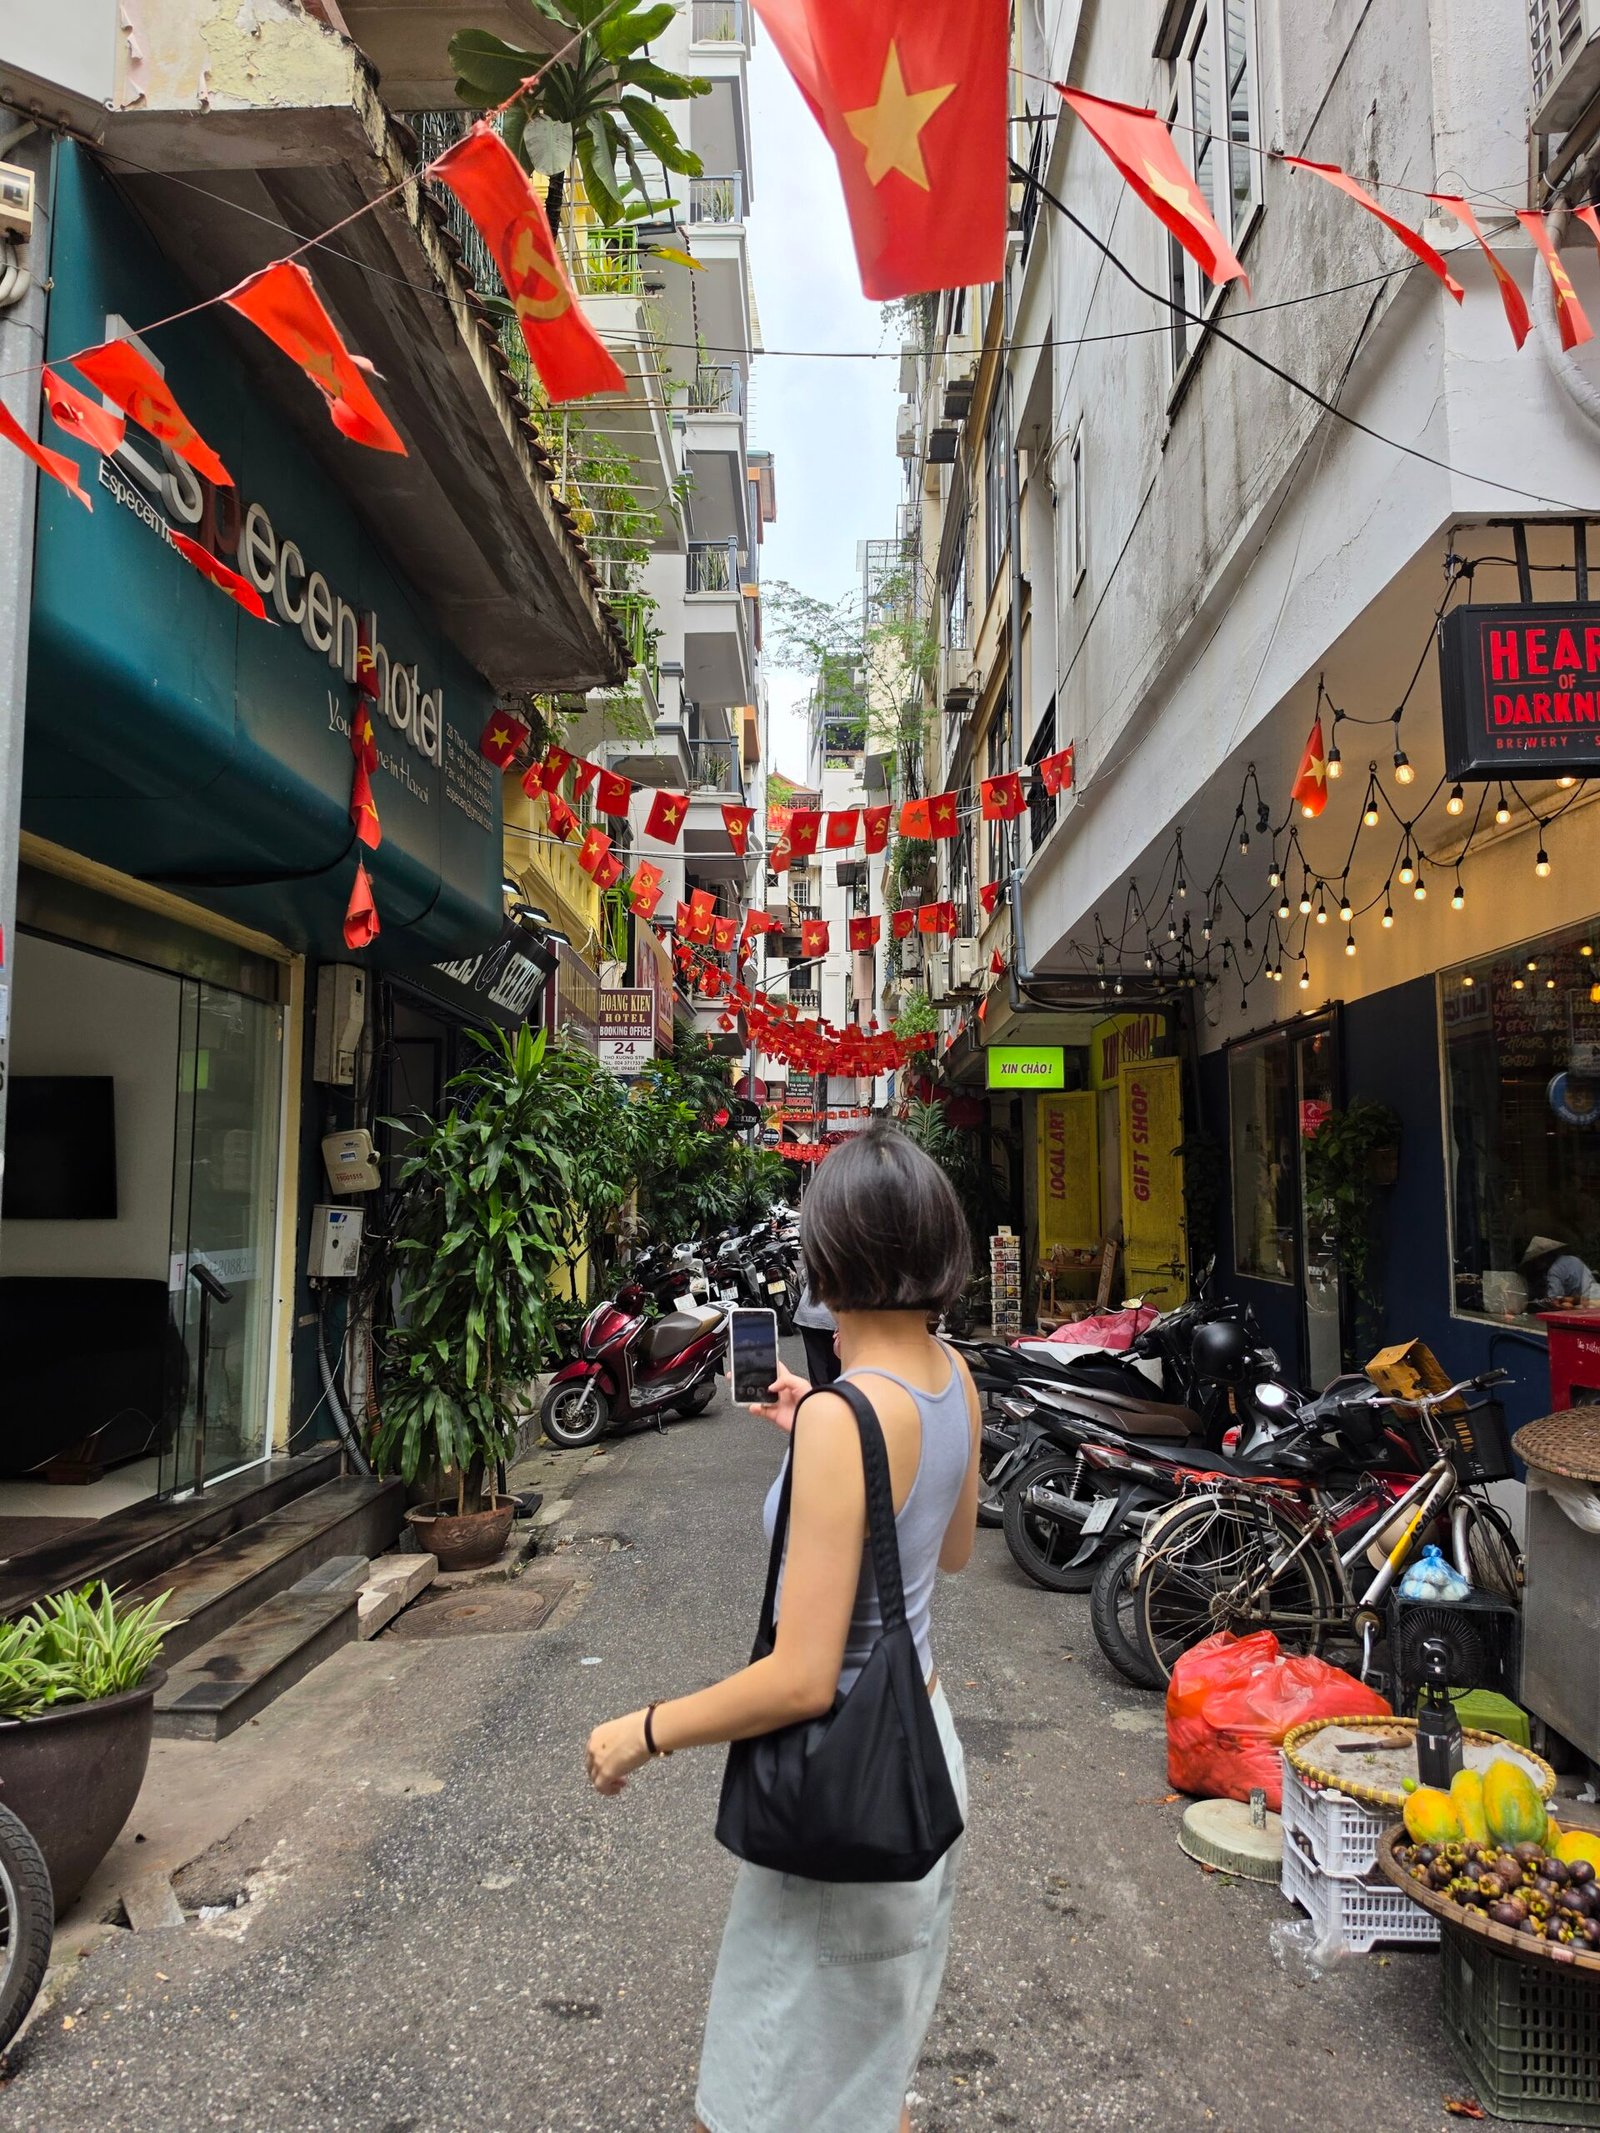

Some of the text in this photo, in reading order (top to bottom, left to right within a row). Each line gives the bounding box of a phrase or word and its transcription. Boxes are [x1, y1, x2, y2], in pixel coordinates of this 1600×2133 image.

[98, 458, 160, 535] Especen
[361, 610, 442, 768] hotel
[1559, 673, 1576, 690] OF
[1493, 691, 1600, 725] DARKN
[1496, 736, 1568, 749] BREWERY
[600, 994, 651, 1012] HOANG KIEN
[600, 1026, 651, 1036] BOOKING OFFICE
[605, 1013, 645, 1023] HOTEL
[614, 1042, 635, 1055] 24
[1102, 1031, 1119, 1081] XIN
[1001, 1063, 1018, 1074] XIN
[1049, 1109, 1066, 1200] LOCAL ART
[1131, 1082, 1150, 1202] GIFT SHOP
[1410, 1492, 1446, 1546] ASAMA
